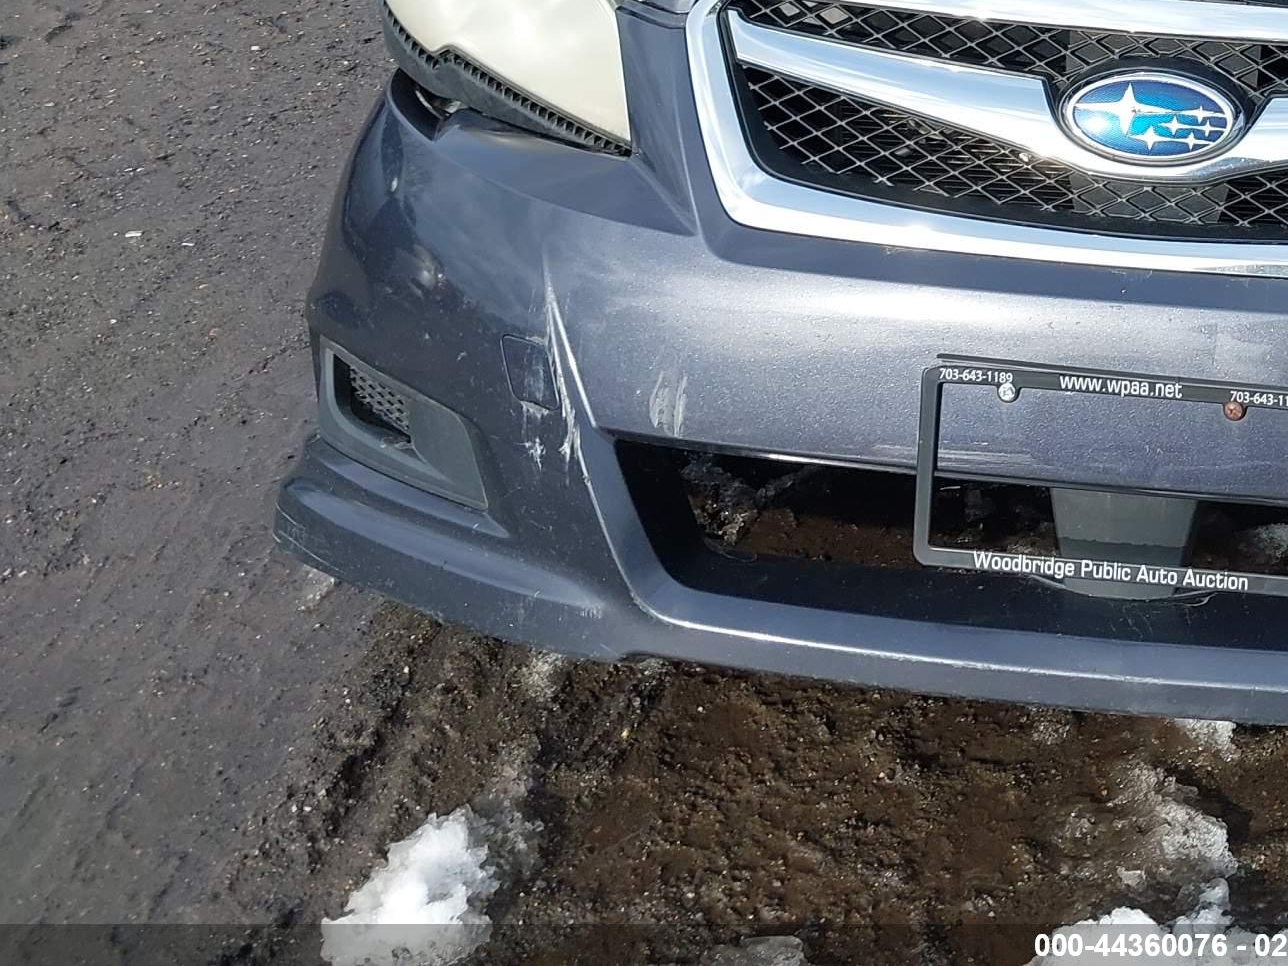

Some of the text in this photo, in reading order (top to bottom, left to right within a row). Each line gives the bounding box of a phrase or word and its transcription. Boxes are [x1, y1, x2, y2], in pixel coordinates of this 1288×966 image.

[938, 367, 1014, 384] 703-643-1189
[1059, 375, 1183, 399] www.wpaa.net
[973, 550, 1249, 592] Woodbridge Public Auto Auction
